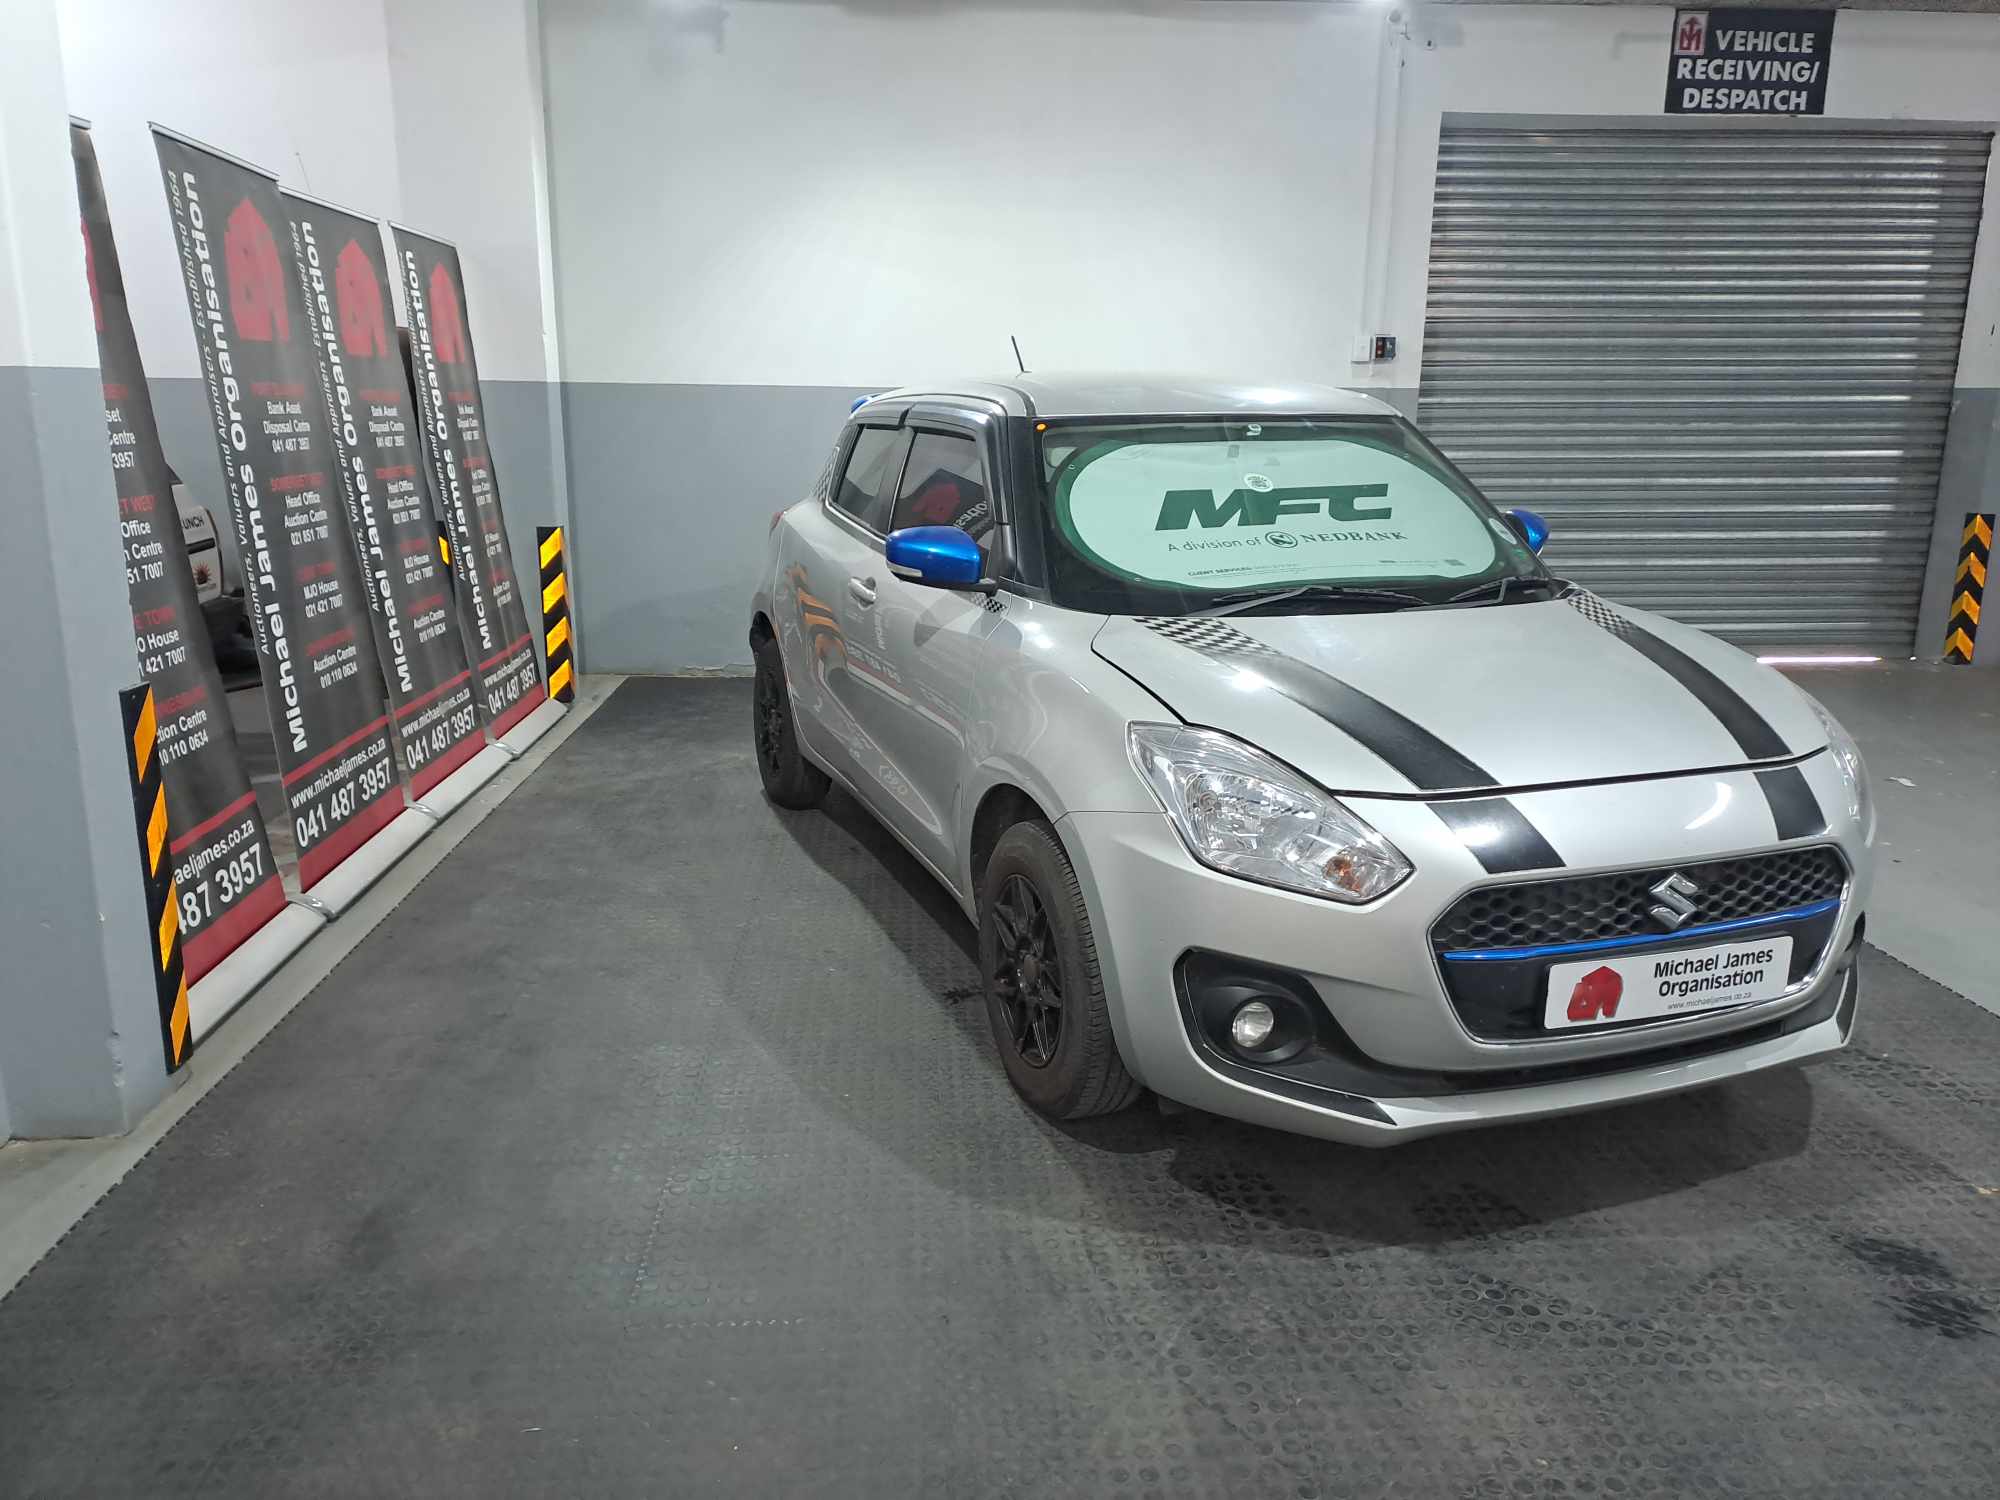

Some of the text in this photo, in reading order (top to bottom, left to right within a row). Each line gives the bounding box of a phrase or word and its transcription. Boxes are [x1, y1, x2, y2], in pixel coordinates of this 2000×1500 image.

[1715, 29, 1816, 53] VEHICLE
[1676, 57, 1821, 83] RECEIVING/
[1682, 87, 1808, 111] DESPATCH
[167, 169, 184, 217] 1964
[180, 222, 206, 329] Established
[302, 221, 358, 447] Organisation
[405, 250, 448, 440] Organisation
[203, 345, 228, 437] Appraisers
[112, 452, 135, 469] 3957
[183, 171, 308, 753] Michael James Organisation
[222, 441, 234, 478] and
[229, 482, 248, 546] Valuers
[352, 456, 384, 560] James
[444, 449, 469, 537] James
[1154, 483, 1393, 531] MFC
[120, 519, 151, 538] Office
[132, 540, 163, 559] Centre
[1167, 531, 1408, 552] A division of NEDBANK
[142, 561, 164, 579] 7007
[462, 545, 492, 650] Michael
[147, 629, 180, 650] House
[375, 569, 413, 693] Michael
[145, 654, 164, 674] 421
[165, 646, 186, 666] 7007
[488, 662, 537, 714] 041 487 3957
[169, 739, 187, 760] 110
[188, 728, 208, 751] 0634
[178, 709, 207, 732] Centre
[406, 704, 475, 770] 041 487 3957
[291, 737, 386, 809] www.michaeljames.co.za
[296, 756, 391, 848] 041 487 3957
[174, 819, 255, 885] aeljames.co.za
[215, 843, 263, 903] 3957
[1654, 949, 1773, 978] Michael James
[1658, 969, 1764, 997] Organisation
